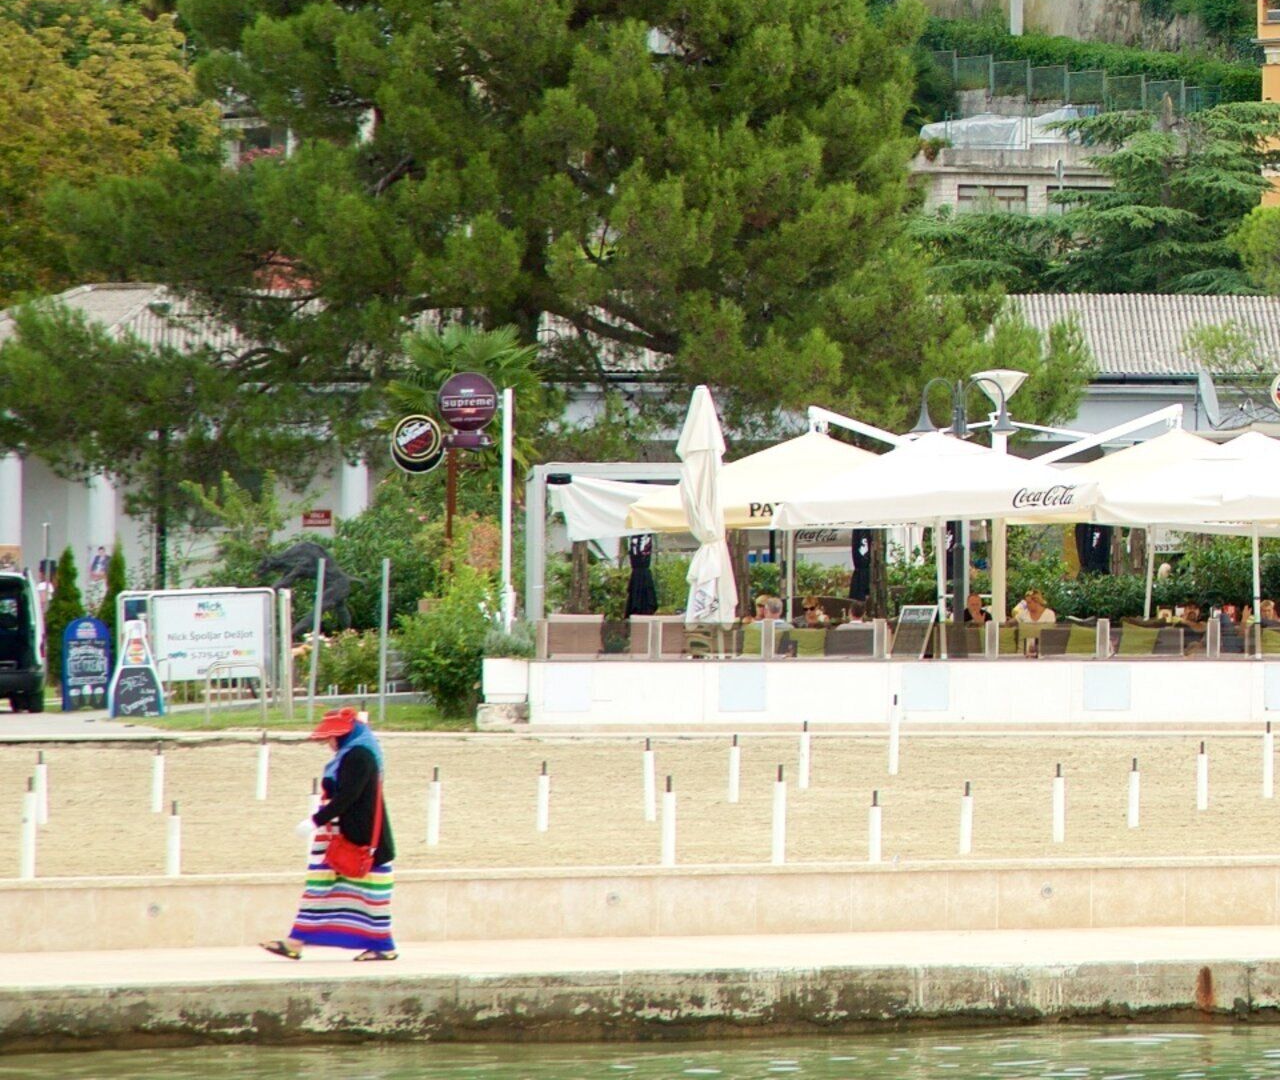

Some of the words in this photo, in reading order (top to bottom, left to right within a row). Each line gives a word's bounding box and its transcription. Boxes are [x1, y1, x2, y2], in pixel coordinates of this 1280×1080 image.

[443, 398, 493, 407] supreme
[1012, 485, 1078, 508] Coca-Cola
[748, 502, 780, 517] PA
